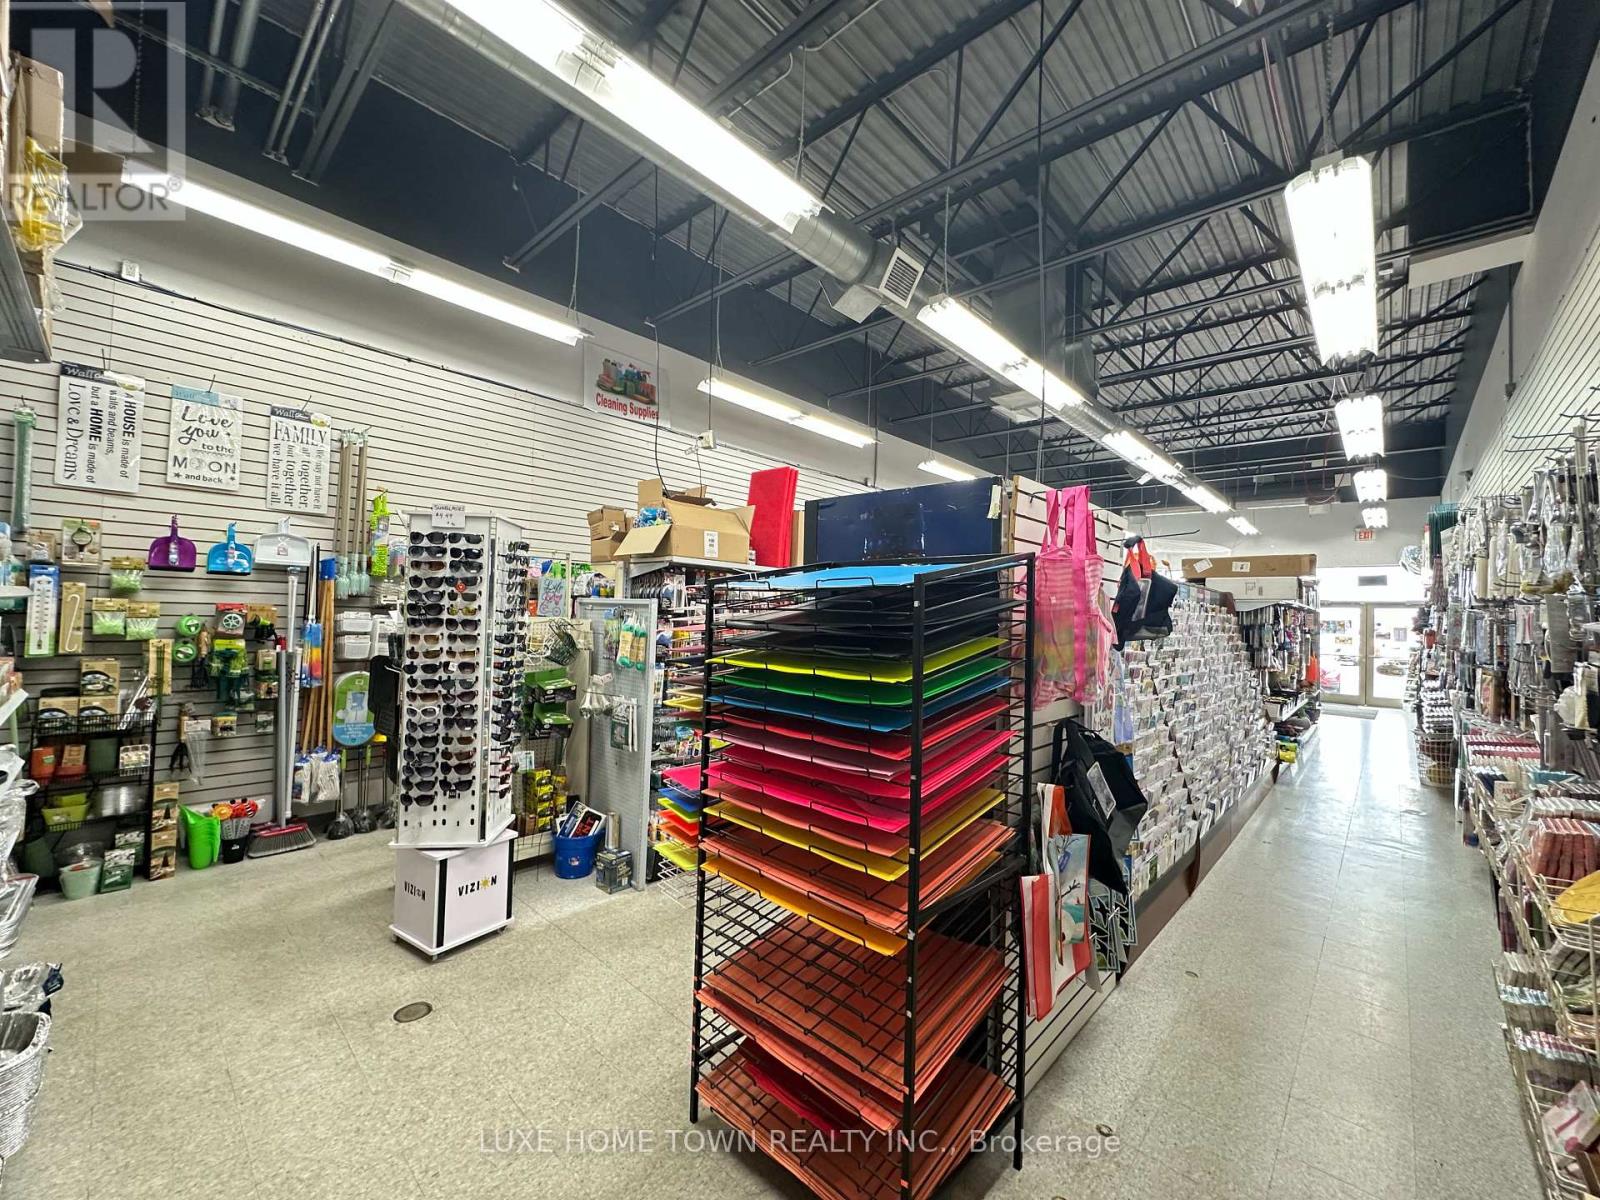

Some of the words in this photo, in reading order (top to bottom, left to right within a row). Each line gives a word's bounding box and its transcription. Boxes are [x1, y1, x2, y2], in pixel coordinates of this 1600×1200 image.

[68, 382, 86, 415] Love
[91, 386, 102, 399] but
[108, 389, 119, 410] walls
[595, 392, 628, 416] Cleaning
[67, 416, 80, 425] &
[89, 408, 104, 442] HOME
[107, 410, 118, 427] and
[123, 401, 137, 438] HOUSE
[181, 405, 234, 428] Love
[105, 427, 117, 455] beams,
[121, 438, 130, 448] is
[178, 425, 220, 445] you
[273, 420, 327, 447] FAMILY
[63, 426, 84, 480] Dreams
[87, 442, 98, 451] is
[202, 443, 215, 451] to
[216, 444, 235, 454] the
[272, 443, 281, 455] we
[286, 444, 296, 457] but
[86, 451, 96, 473] made
[120, 448, 129, 468] made
[119, 470, 129, 479] of
[184, 473, 201, 481] and
[202, 474, 223, 484] back
[271, 458, 283, 480] have
[85, 475, 96, 484] of
[282, 460, 297, 507] together
[314, 475, 322, 486] not
